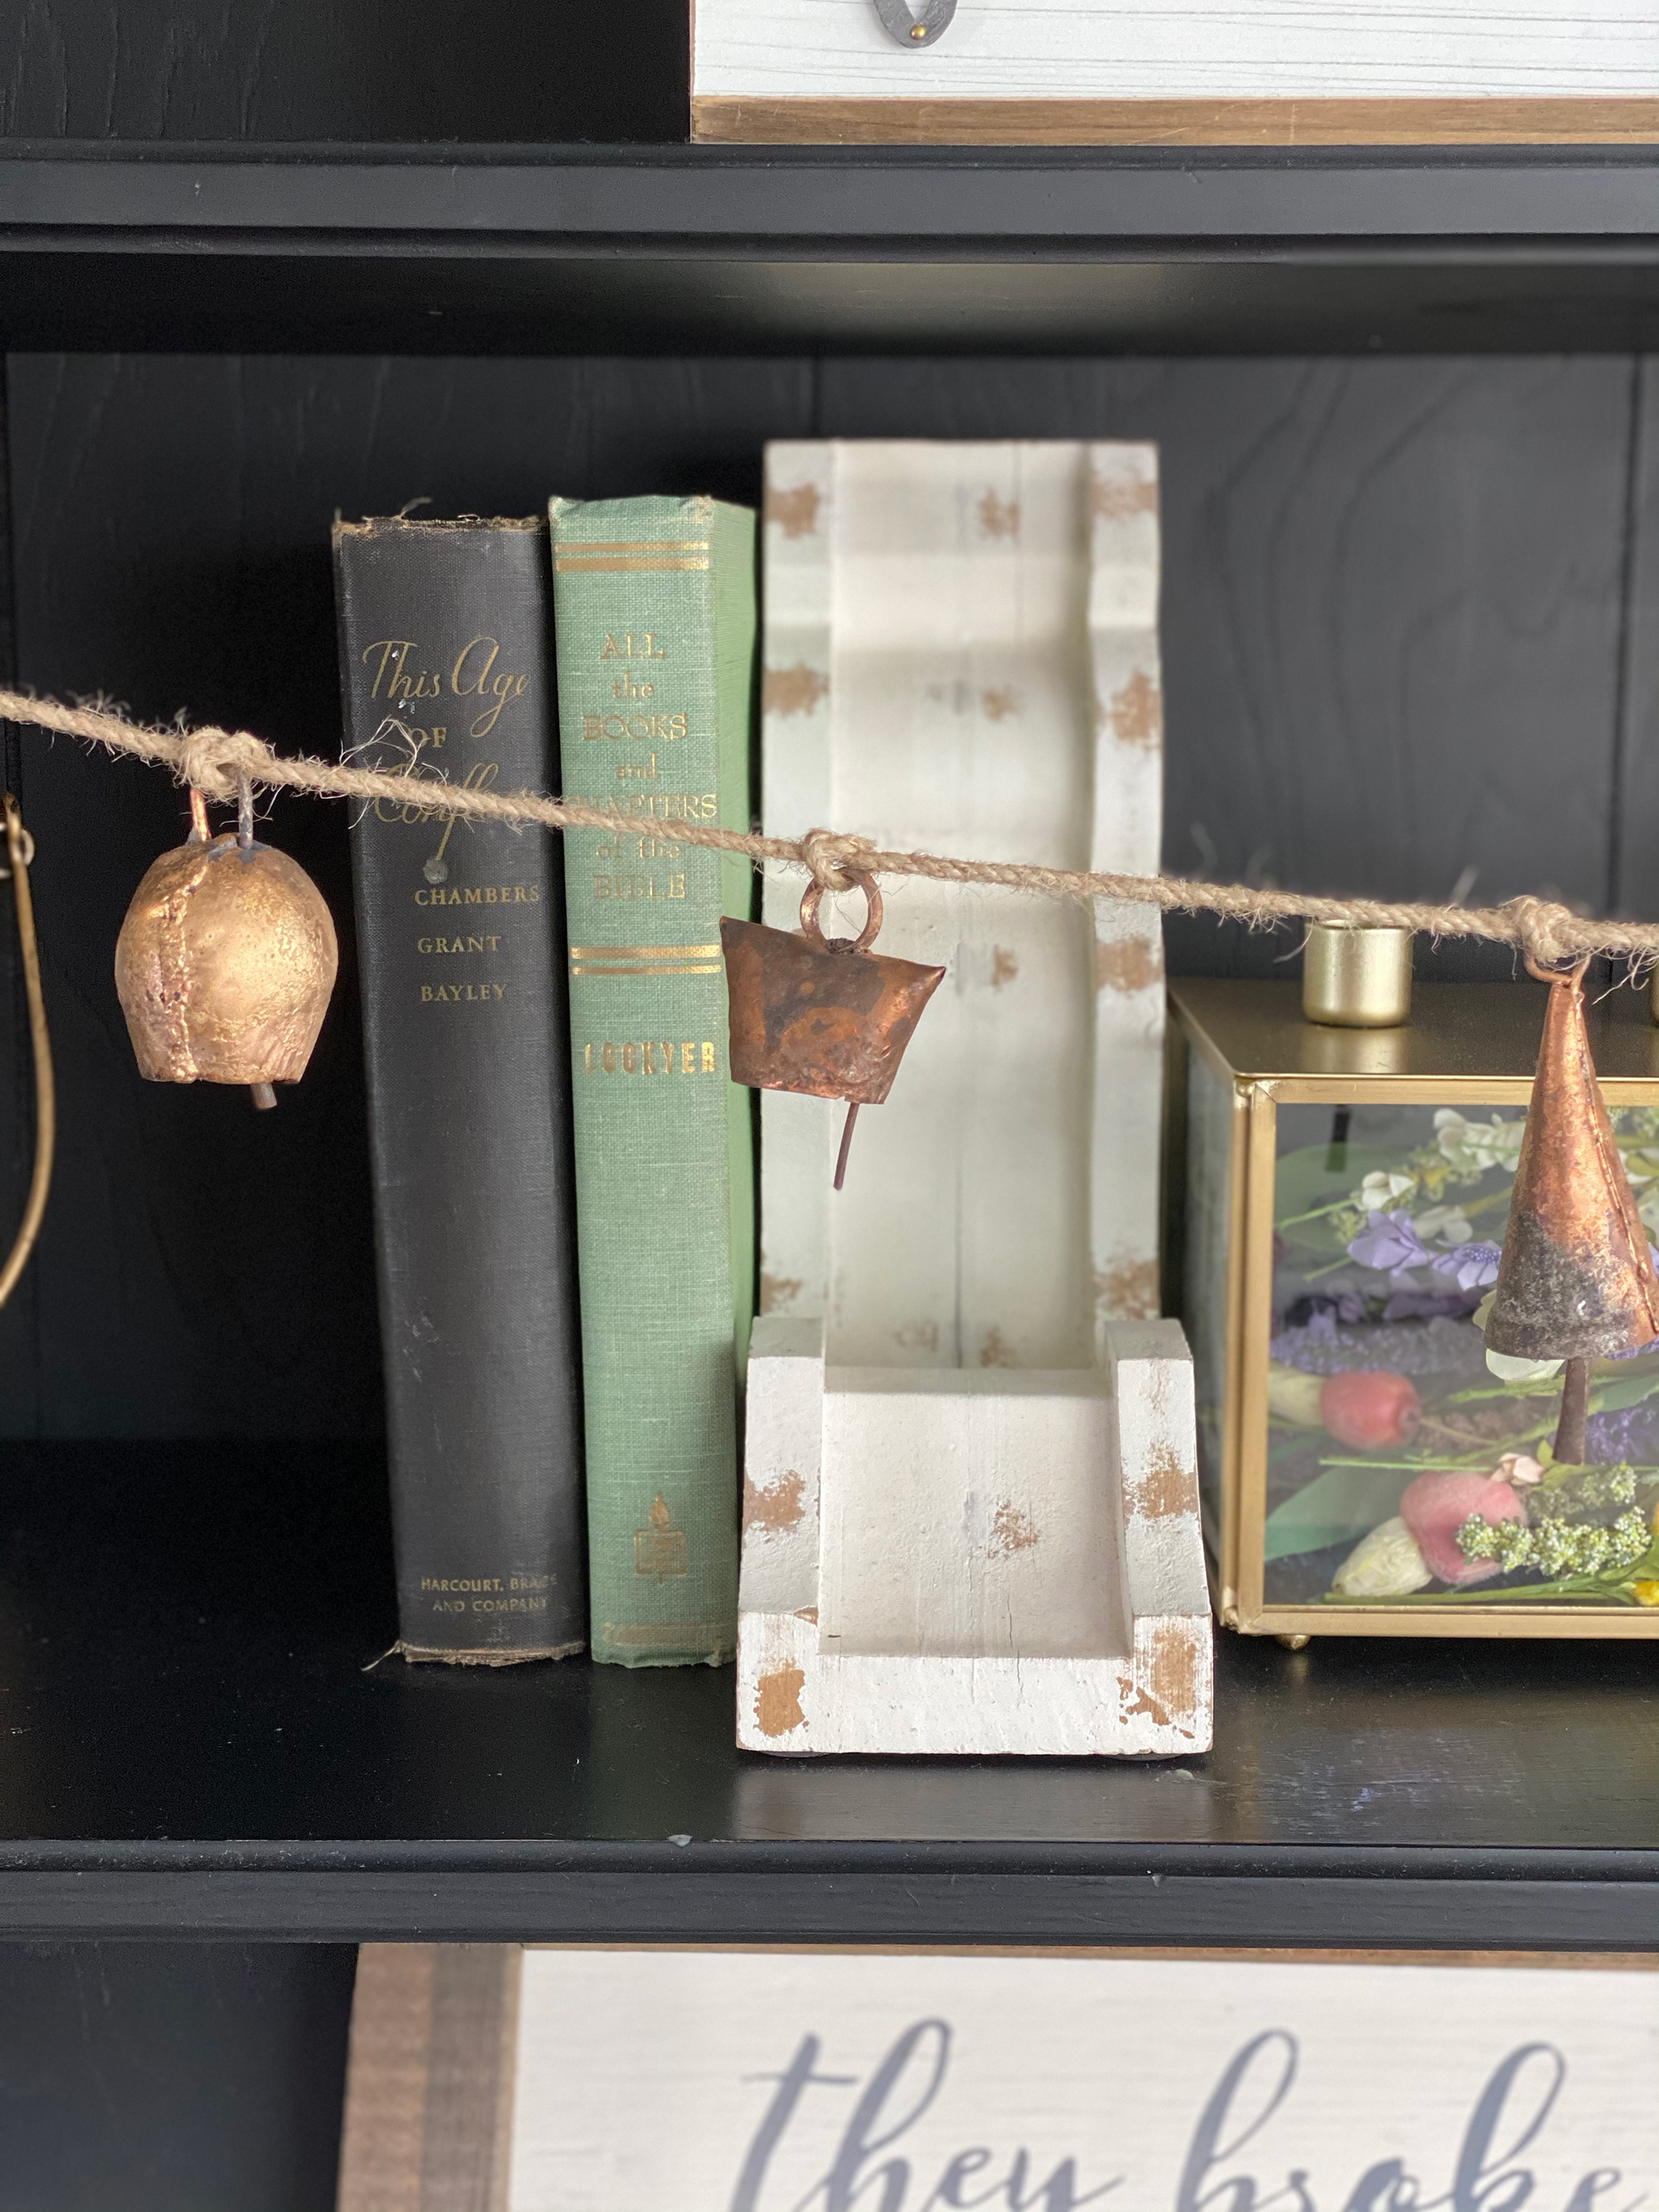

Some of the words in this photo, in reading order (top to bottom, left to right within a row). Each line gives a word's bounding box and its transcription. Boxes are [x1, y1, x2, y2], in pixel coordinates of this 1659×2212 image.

[600, 633, 664, 659] ALL
[362, 640, 440, 698] This
[451, 636, 531, 737] Age
[611, 670, 654, 699] the
[408, 726, 447, 748] OF
[581, 712, 688, 741] BOOKS
[614, 752, 660, 780] and
[415, 885, 539, 906] CHAMBERS
[593, 873, 685, 899] BIBLE
[417, 935, 502, 953] GRANT
[420, 983, 507, 1002] BAYLEY
[583, 1041, 715, 1075] LOCKYER
[432, 1600, 465, 1612] AND
[472, 1597, 547, 1612] COMPANY
